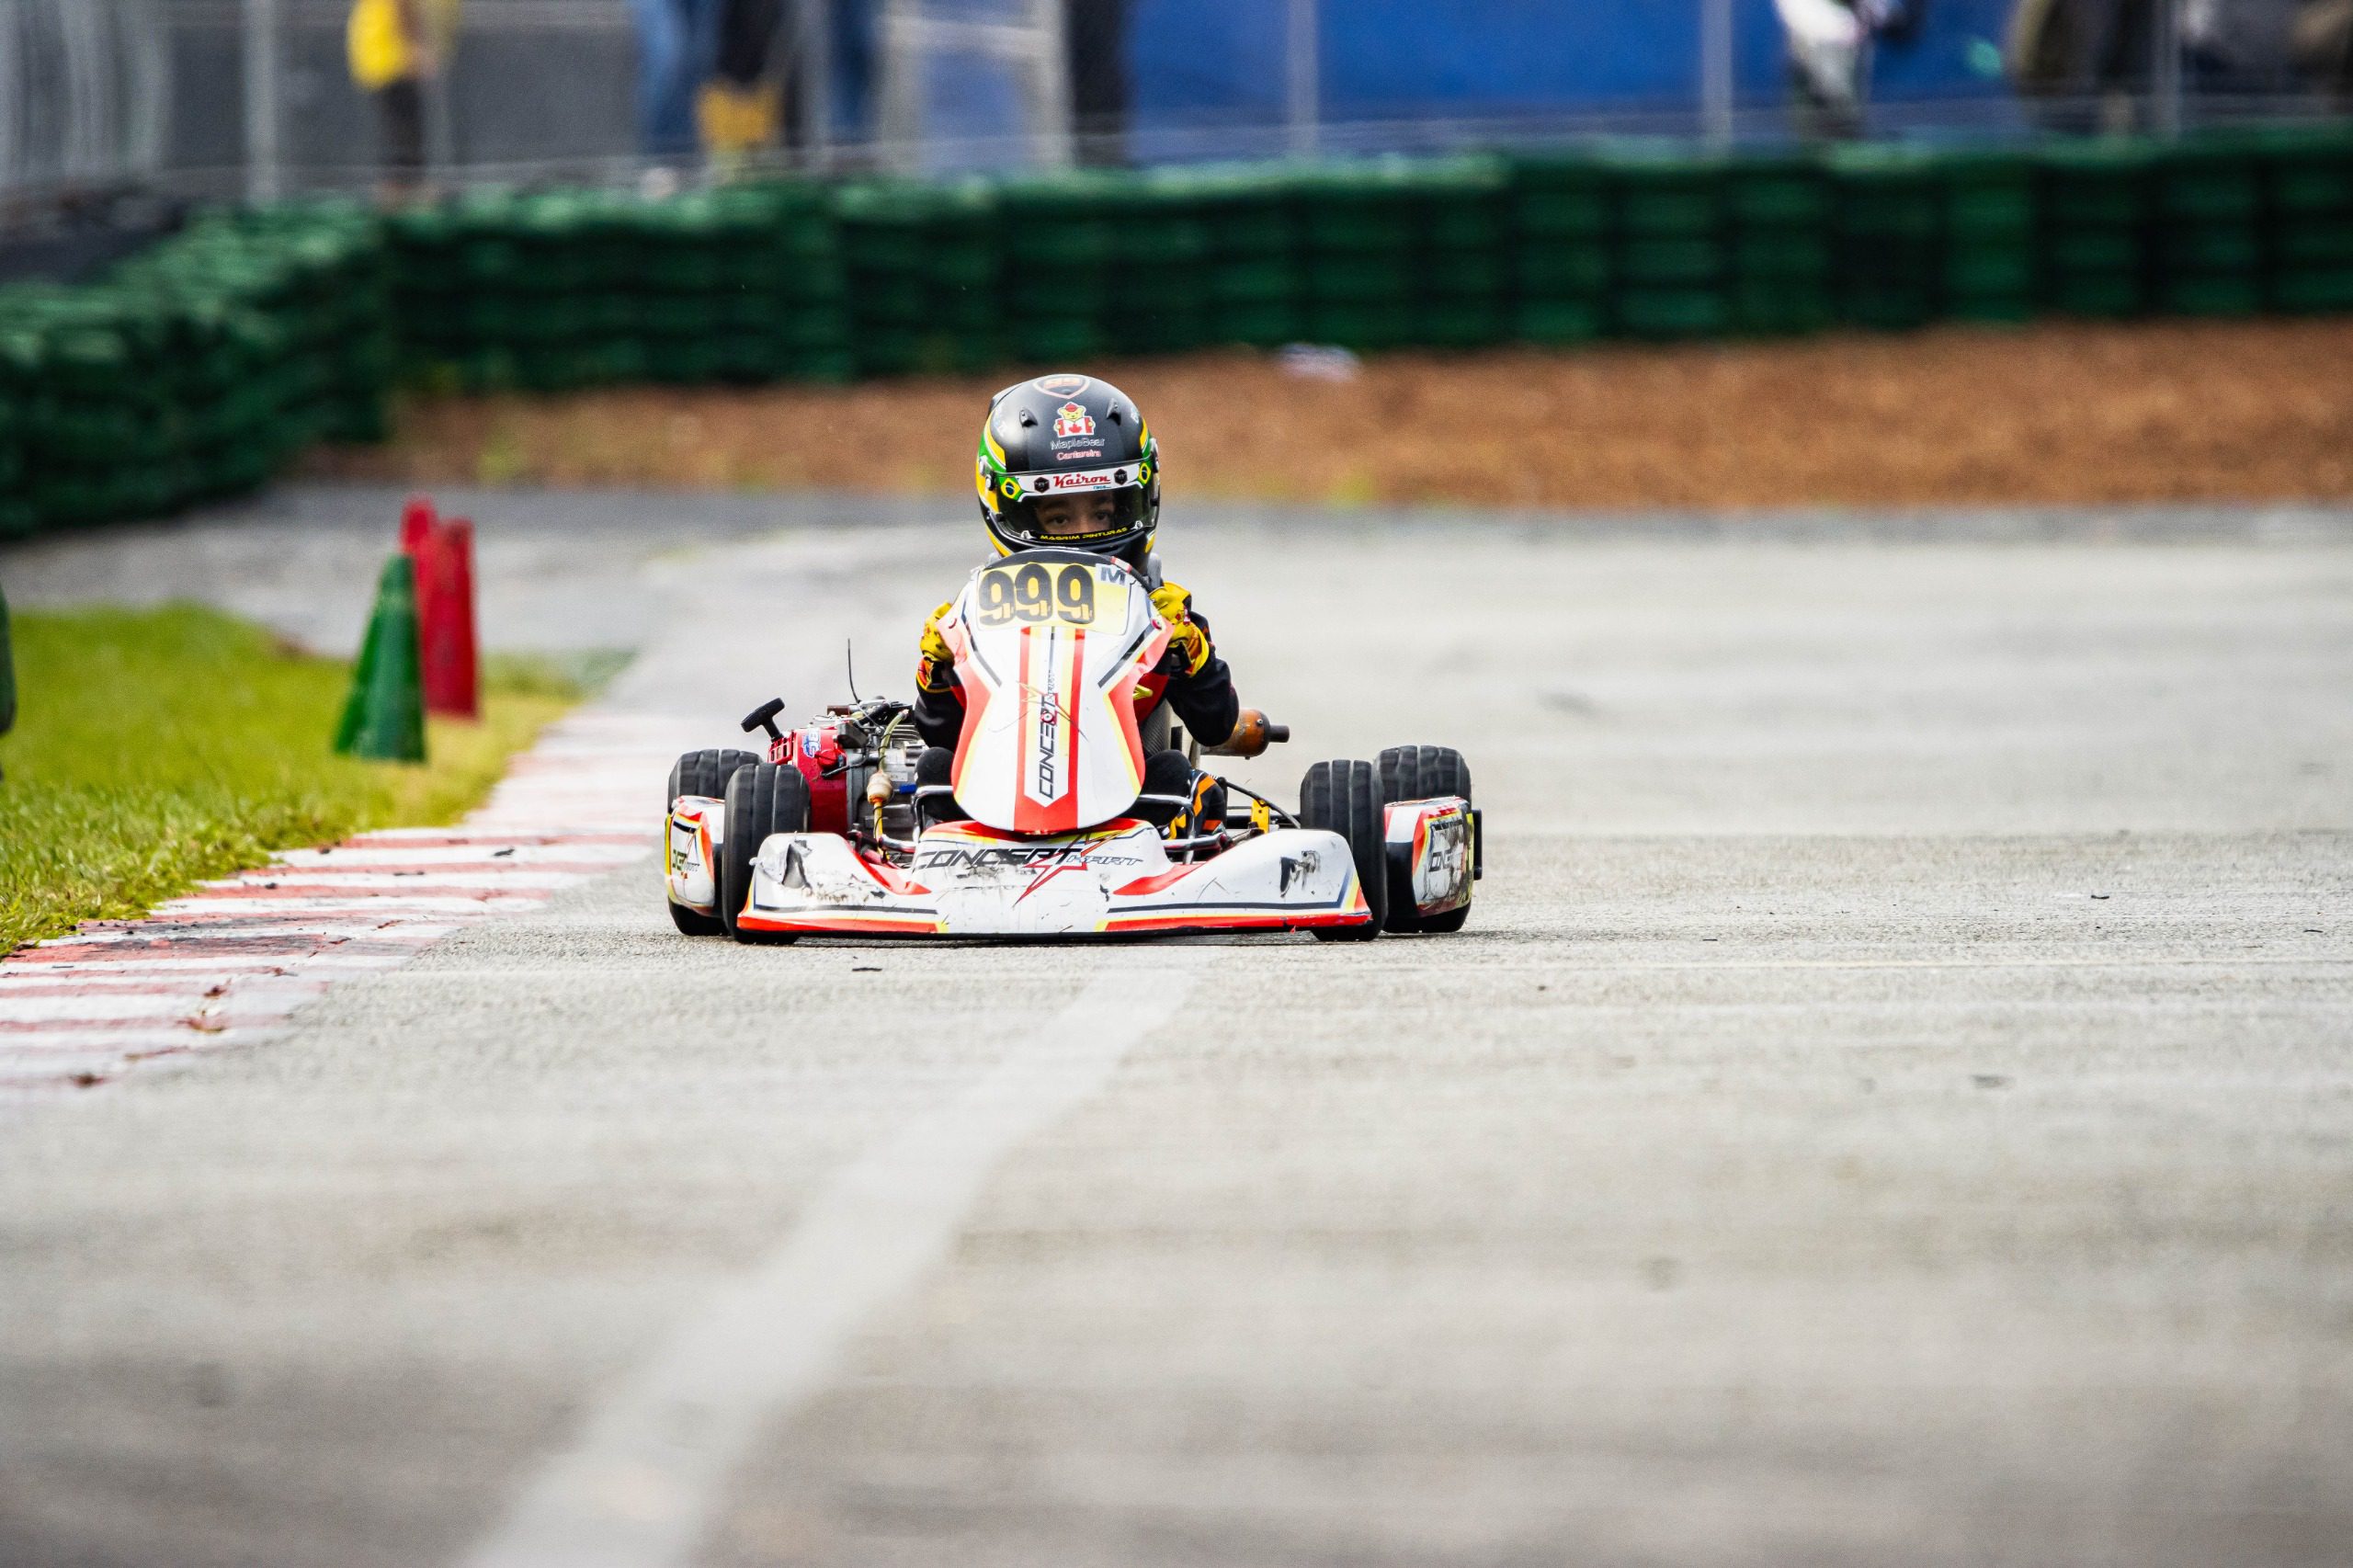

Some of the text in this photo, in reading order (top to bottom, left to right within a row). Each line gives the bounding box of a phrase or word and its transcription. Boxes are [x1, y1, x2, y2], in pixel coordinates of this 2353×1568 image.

[1053, 472, 1110, 488] Kairon
[979, 562, 1126, 626] 999 M
